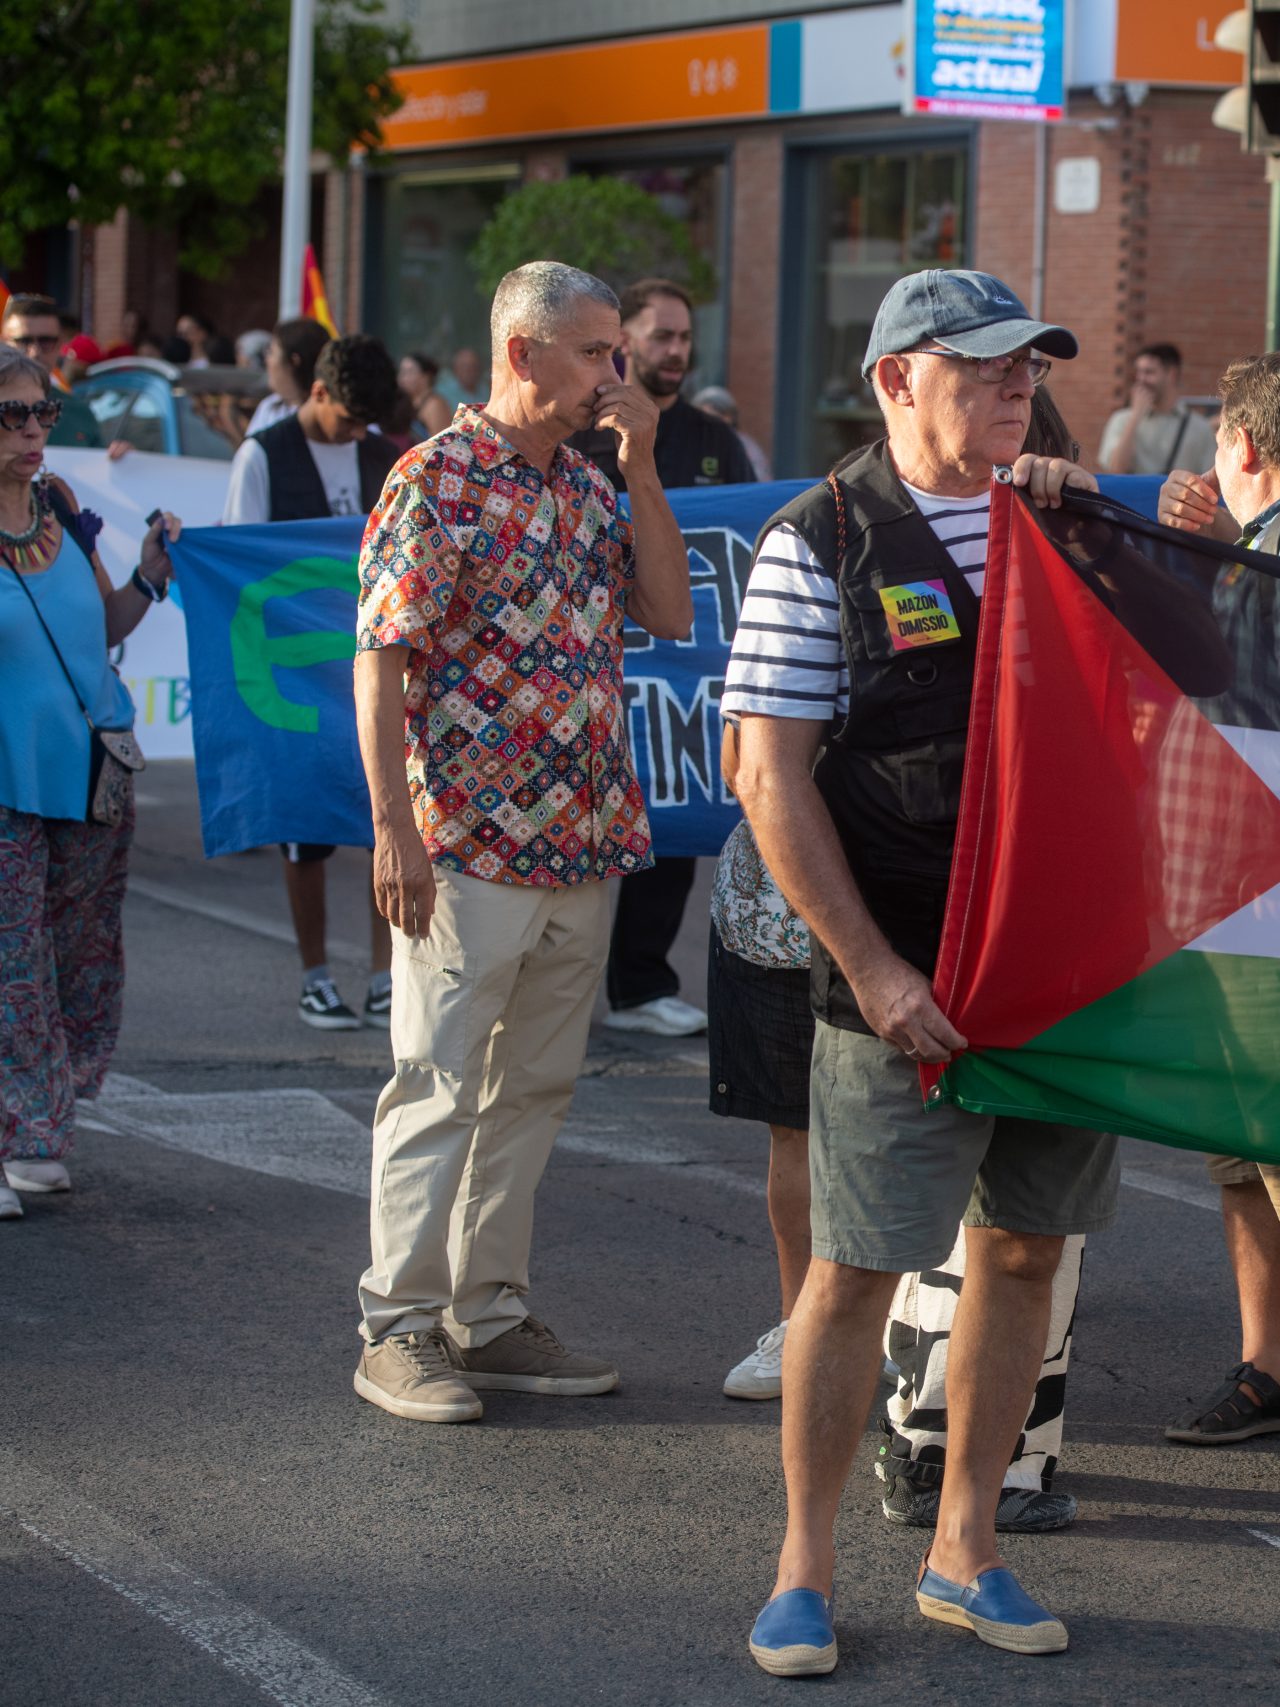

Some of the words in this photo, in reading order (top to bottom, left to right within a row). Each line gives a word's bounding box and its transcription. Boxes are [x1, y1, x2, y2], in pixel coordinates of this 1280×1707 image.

[932, 57, 1044, 92] actual
[896, 592, 939, 616] MAZÓN
[897, 611, 949, 637] DIMISSIÓ
